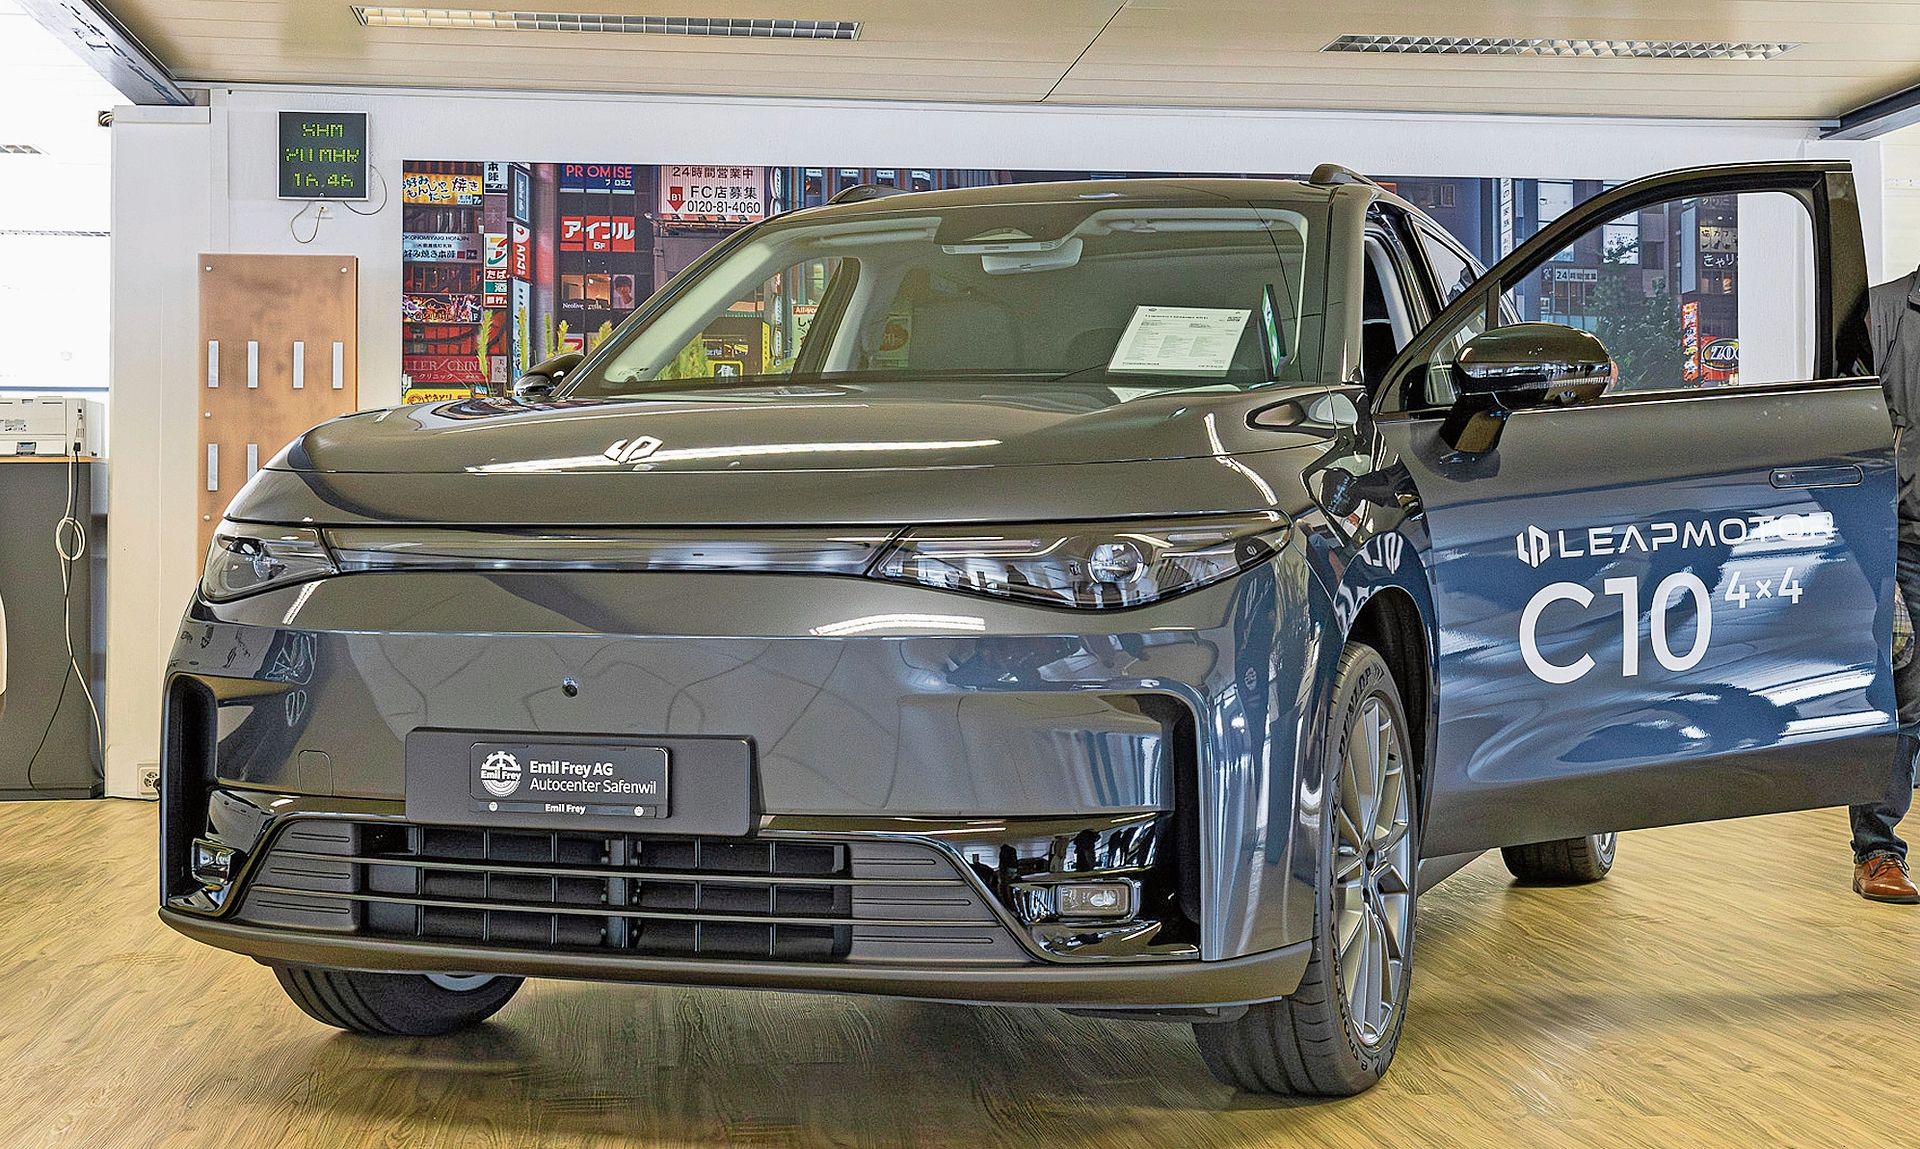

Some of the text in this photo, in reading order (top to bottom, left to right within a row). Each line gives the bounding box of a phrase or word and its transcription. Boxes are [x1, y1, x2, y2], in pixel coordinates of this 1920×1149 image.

[566, 164, 632, 179] PROMISE
[672, 167, 753, 179] 24時間営業中
[690, 186, 757, 199] FC店募集
[687, 200, 761, 214] 0120-81-4060
[563, 221, 636, 240] アイフル
[486, 270, 510, 279] たば
[1519, 571, 1713, 685] C10
[480, 769, 521, 781] Emil Frey
[530, 760, 613, 779] Emil Frey AG
[530, 777, 657, 795] Autocenter Safenwil
[545, 803, 586, 815] Emil Frey
